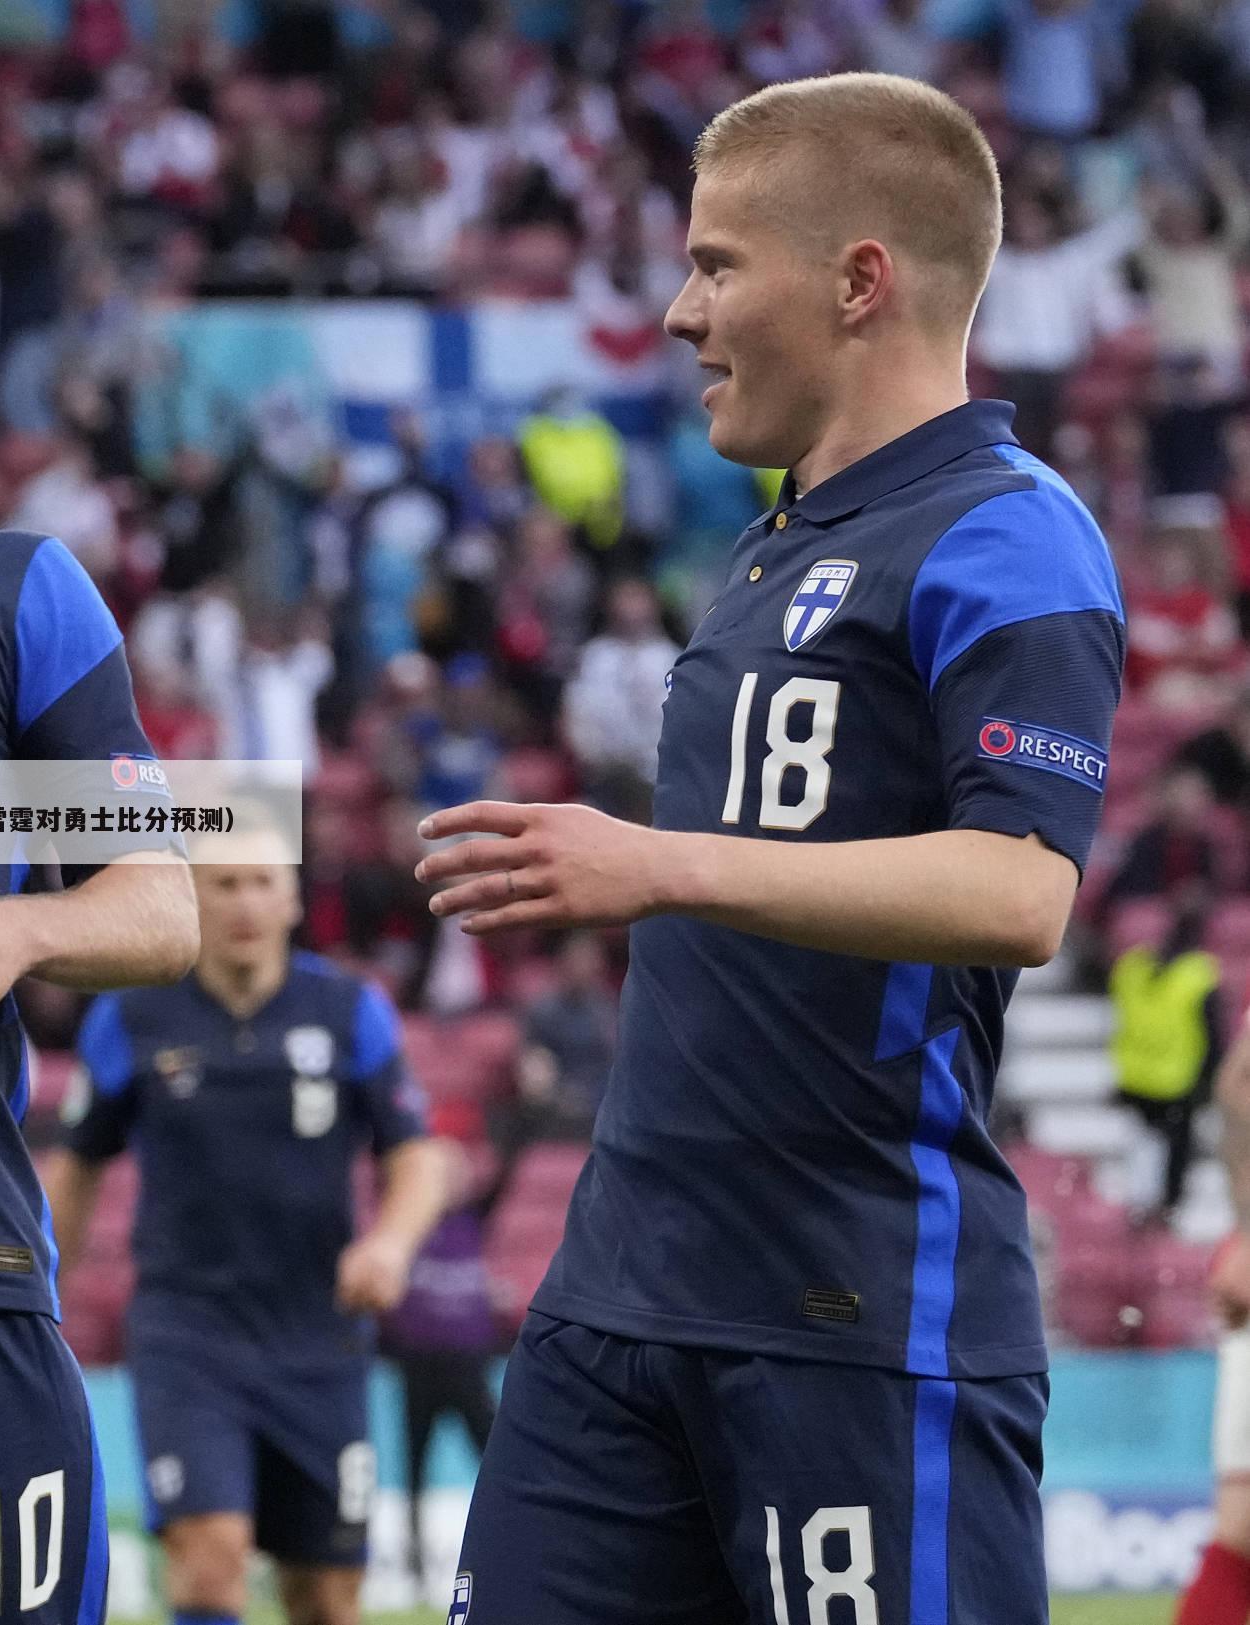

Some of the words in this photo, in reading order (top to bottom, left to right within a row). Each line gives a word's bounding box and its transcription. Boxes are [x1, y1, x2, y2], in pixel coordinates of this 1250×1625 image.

[722, 673, 841, 831] 18
[1019, 735, 1107, 780] RESPECT
[764, 1505, 879, 1625] 18
